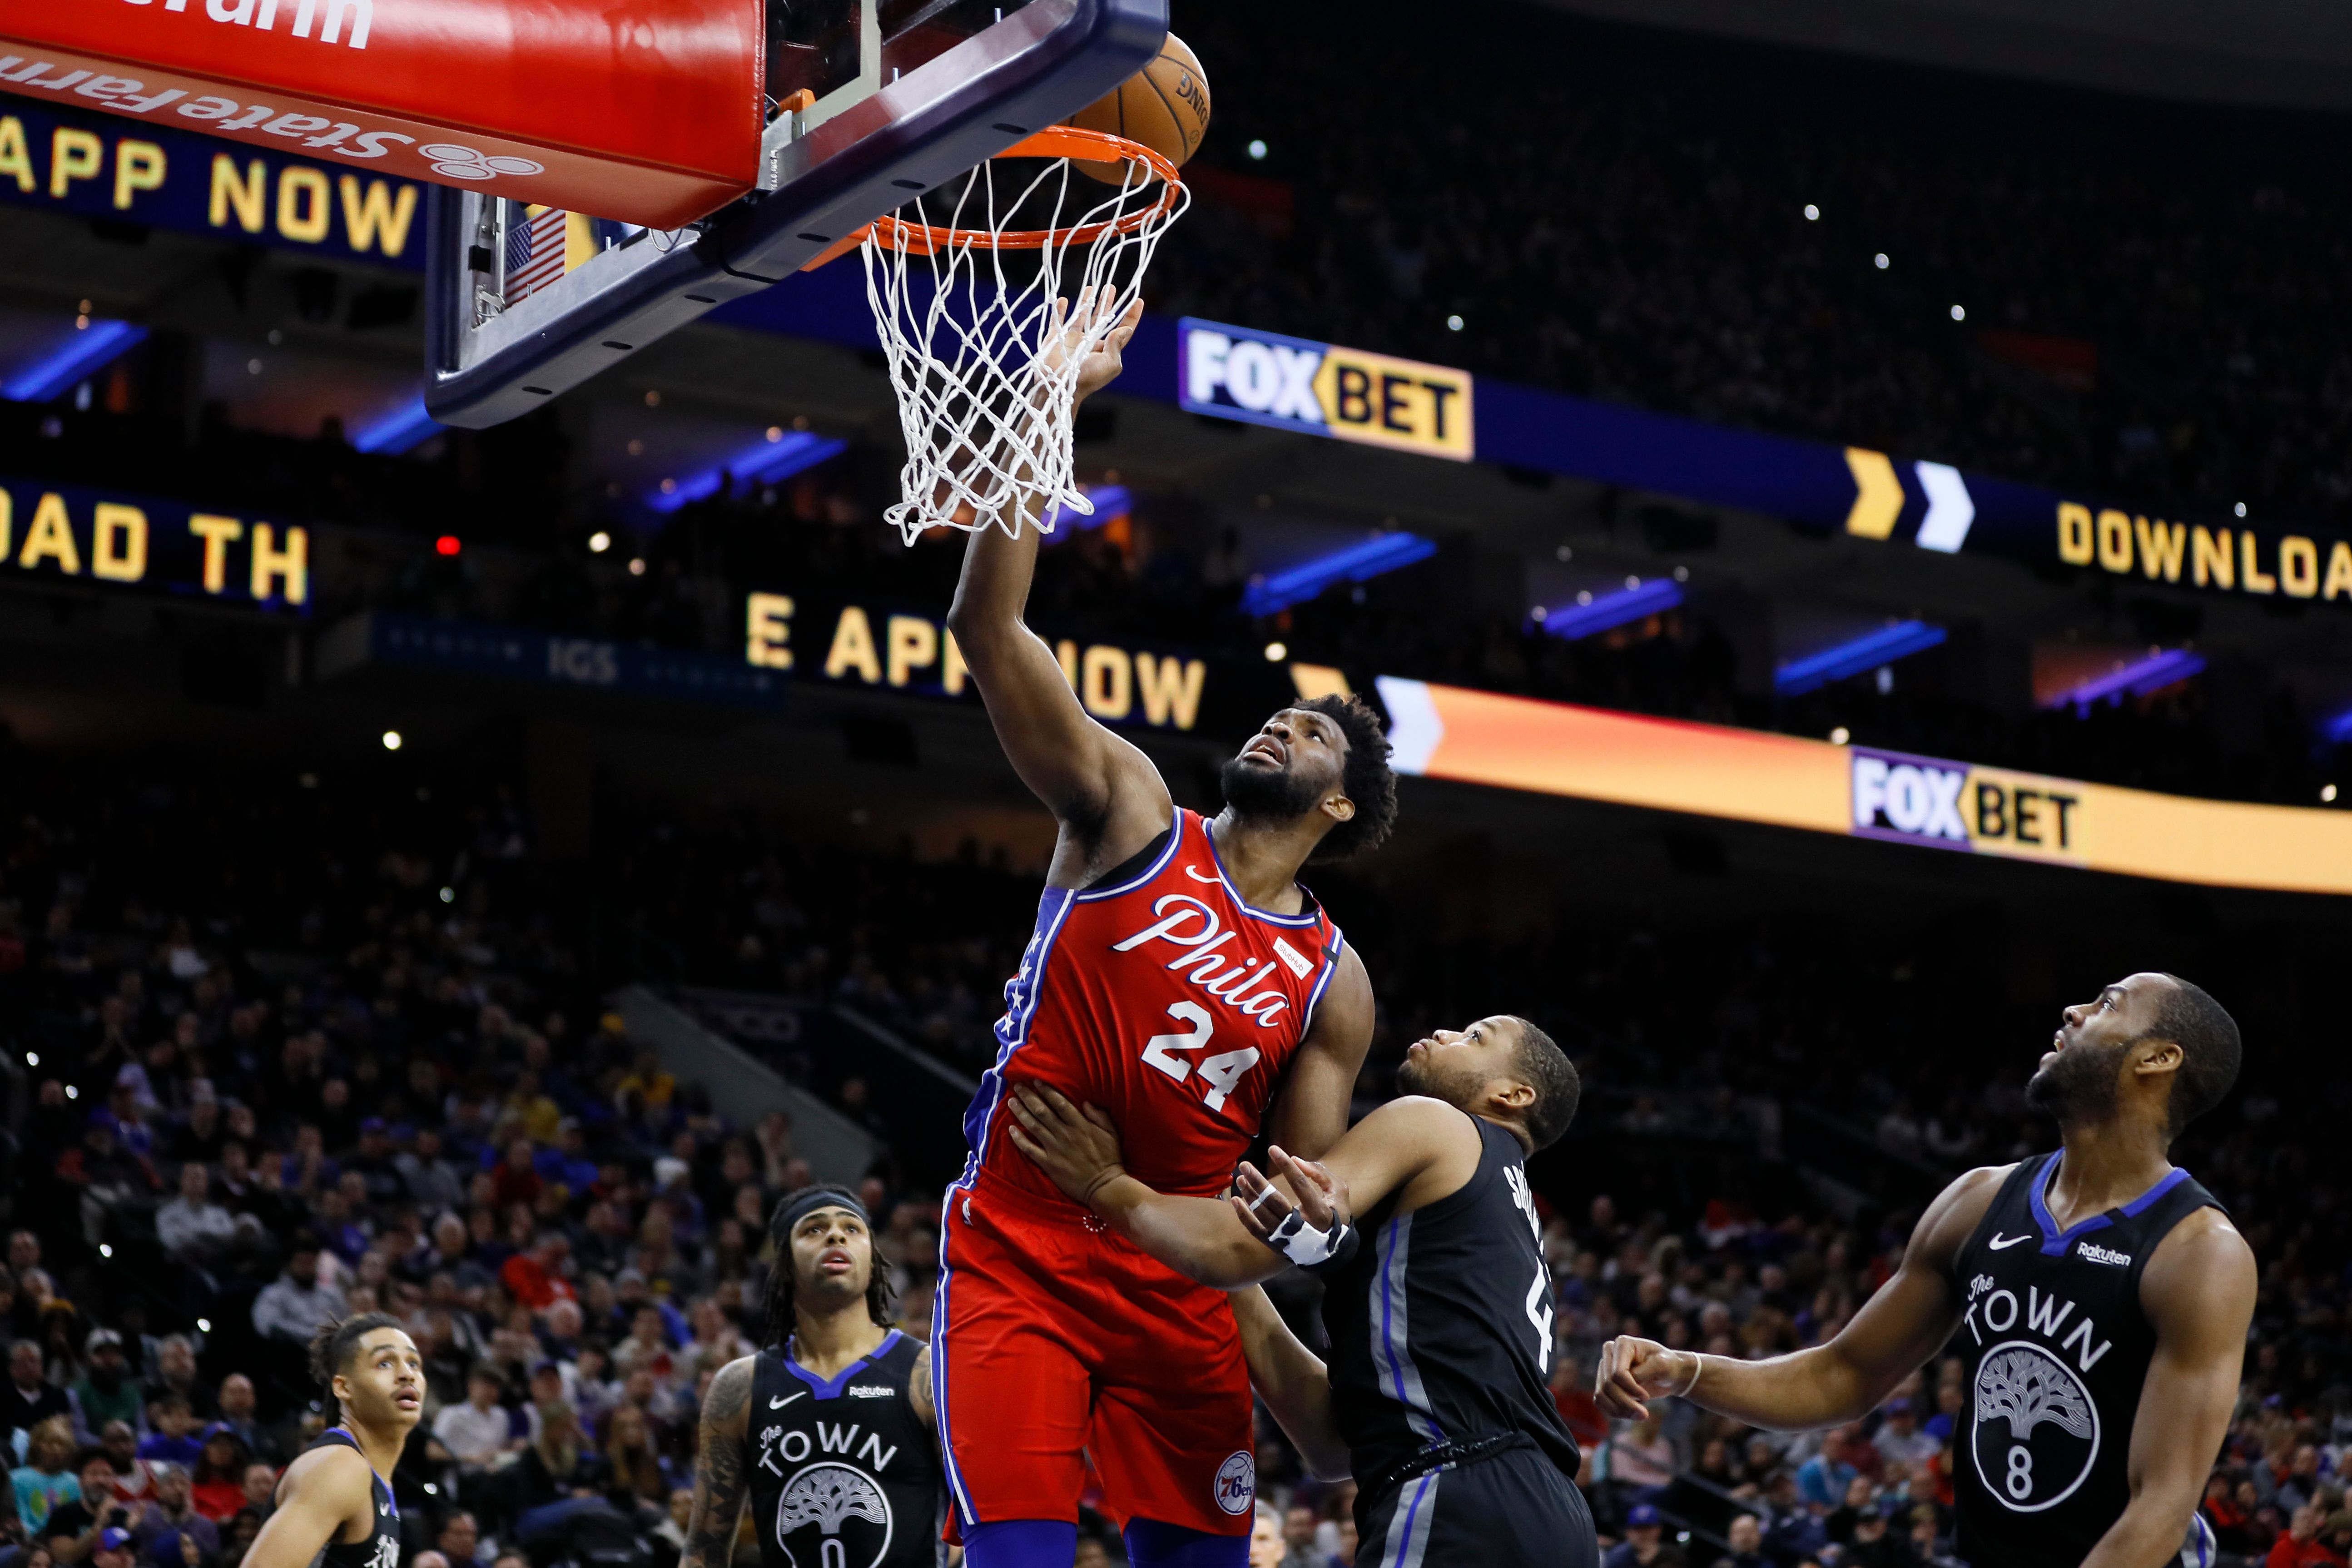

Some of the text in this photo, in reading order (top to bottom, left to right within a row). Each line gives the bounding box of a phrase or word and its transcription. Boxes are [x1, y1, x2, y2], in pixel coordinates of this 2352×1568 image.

[0, 115, 418, 258] APP NOW
[1186, 328, 1458, 440] FOX BET
[0, 485, 308, 605] AD TH
[1853, 755, 2080, 849] FOX BET
[1110, 893, 1290, 1027] Phila
[1278, 944, 1304, 971] StubHub
[1141, 1000, 1260, 1112] 24
[1968, 1273, 1994, 1301] The
[2077, 1241, 2131, 1266] Rakuten
[1526, 1256, 1553, 1374] 4
[1964, 1285, 2112, 1373] TOWN
[849, 1385, 894, 1398] Rakuten
[758, 1421, 897, 1478] TOWN
[760, 1425, 783, 1449] The
[2006, 1445, 2033, 1499] 8
[1220, 1475, 1252, 1498] 76ers
